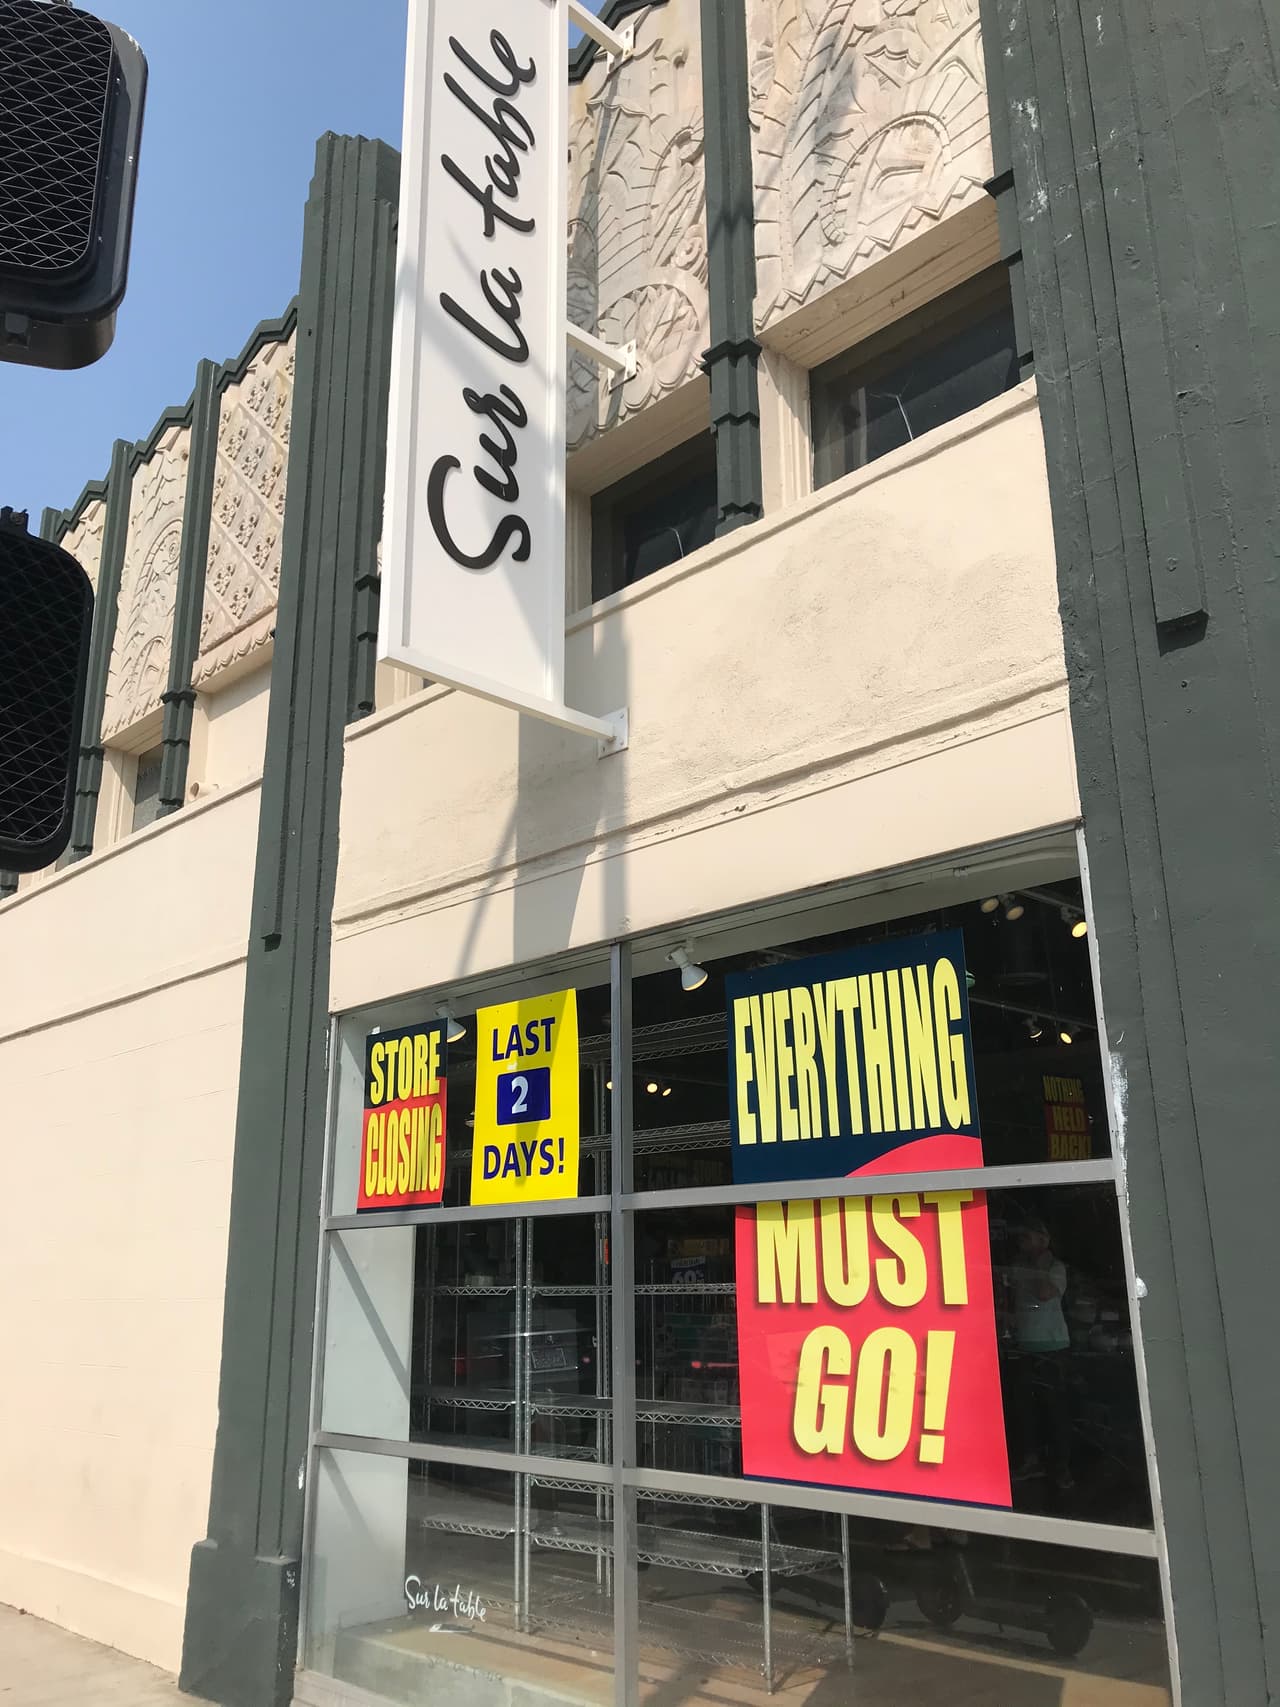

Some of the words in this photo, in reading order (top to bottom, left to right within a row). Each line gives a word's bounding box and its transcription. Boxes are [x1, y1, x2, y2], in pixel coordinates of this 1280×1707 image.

[441, 28, 537, 238] table
[440, 266, 529, 363] la
[427, 383, 531, 570] Sur
[370, 1030, 441, 1105] STORE
[492, 1017, 556, 1062] LAST
[733, 957, 972, 1146] EVERYTHING
[511, 1076, 529, 1115] 2
[365, 1103, 442, 1197] CLOSING
[483, 1137, 565, 1180] DAYS!
[756, 1189, 974, 1307] MUST
[793, 1325, 956, 1464] GO!
[404, 1575, 430, 1609] Sur
[433, 1584, 448, 1611] la
[449, 1584, 487, 1622] table
